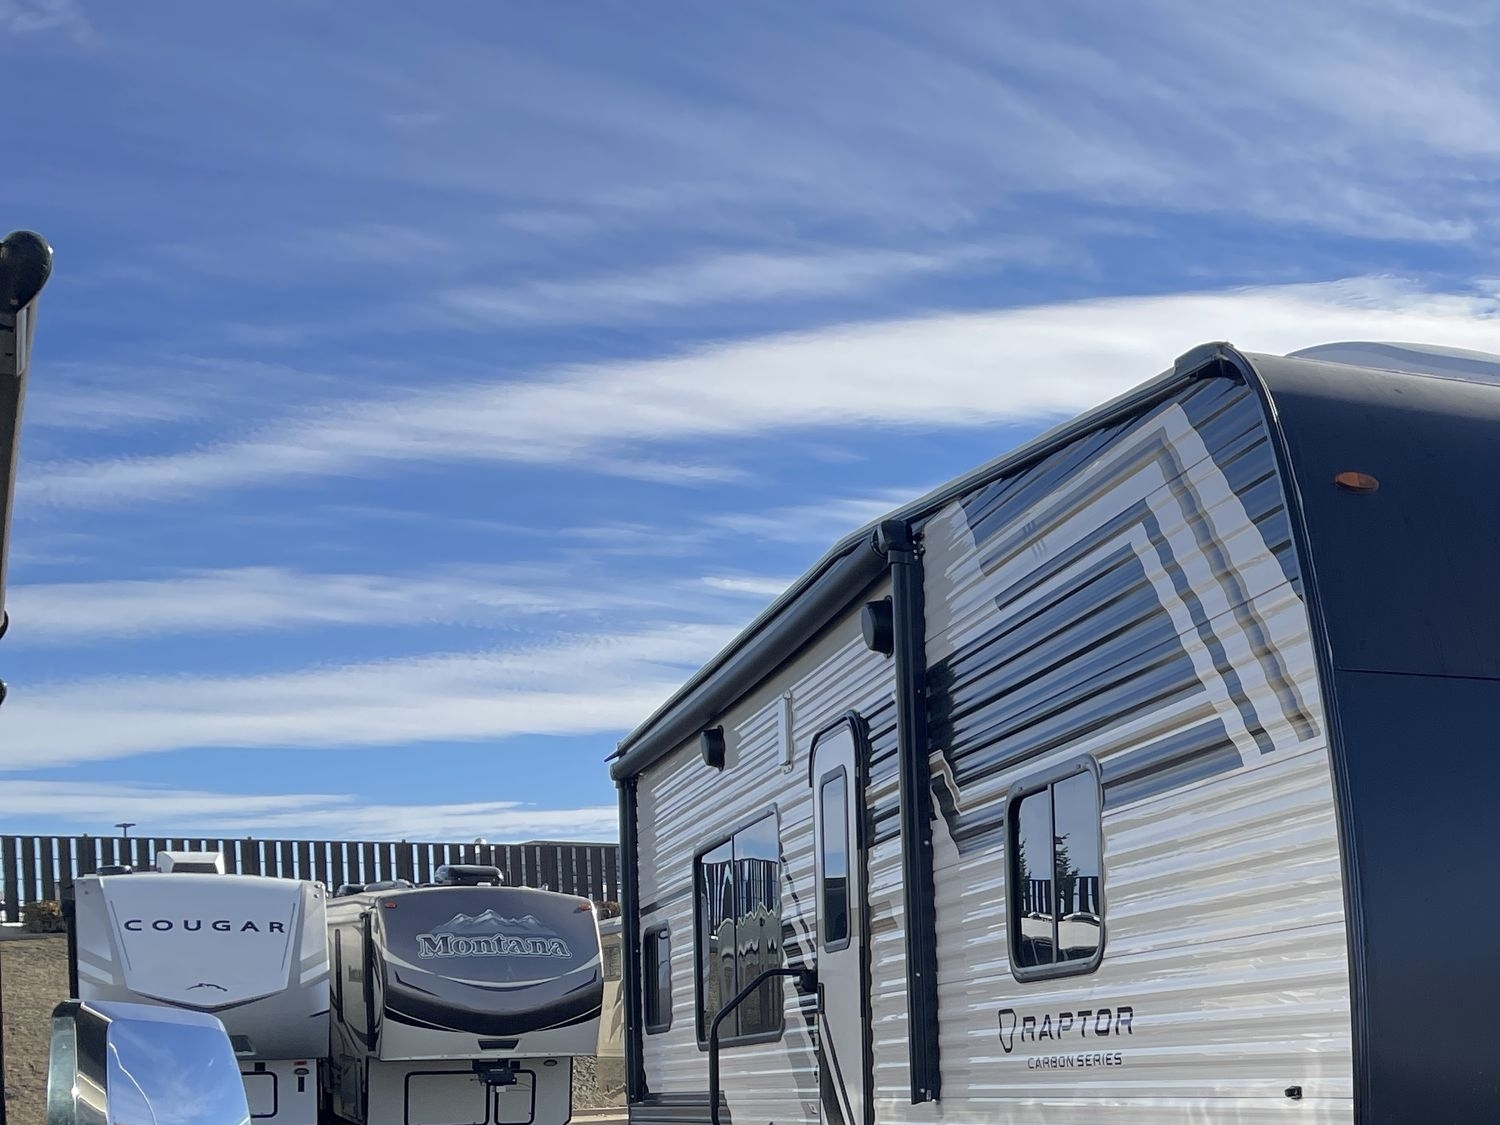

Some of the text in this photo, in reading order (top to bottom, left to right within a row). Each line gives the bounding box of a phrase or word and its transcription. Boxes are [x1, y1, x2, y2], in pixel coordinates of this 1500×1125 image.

[124, 919, 285, 933] COUGAR
[416, 933, 572, 959] Montana
[1021, 1006, 1134, 1042] RAPTOR
[1027, 1052, 1122, 1069] CARBON SERIES
